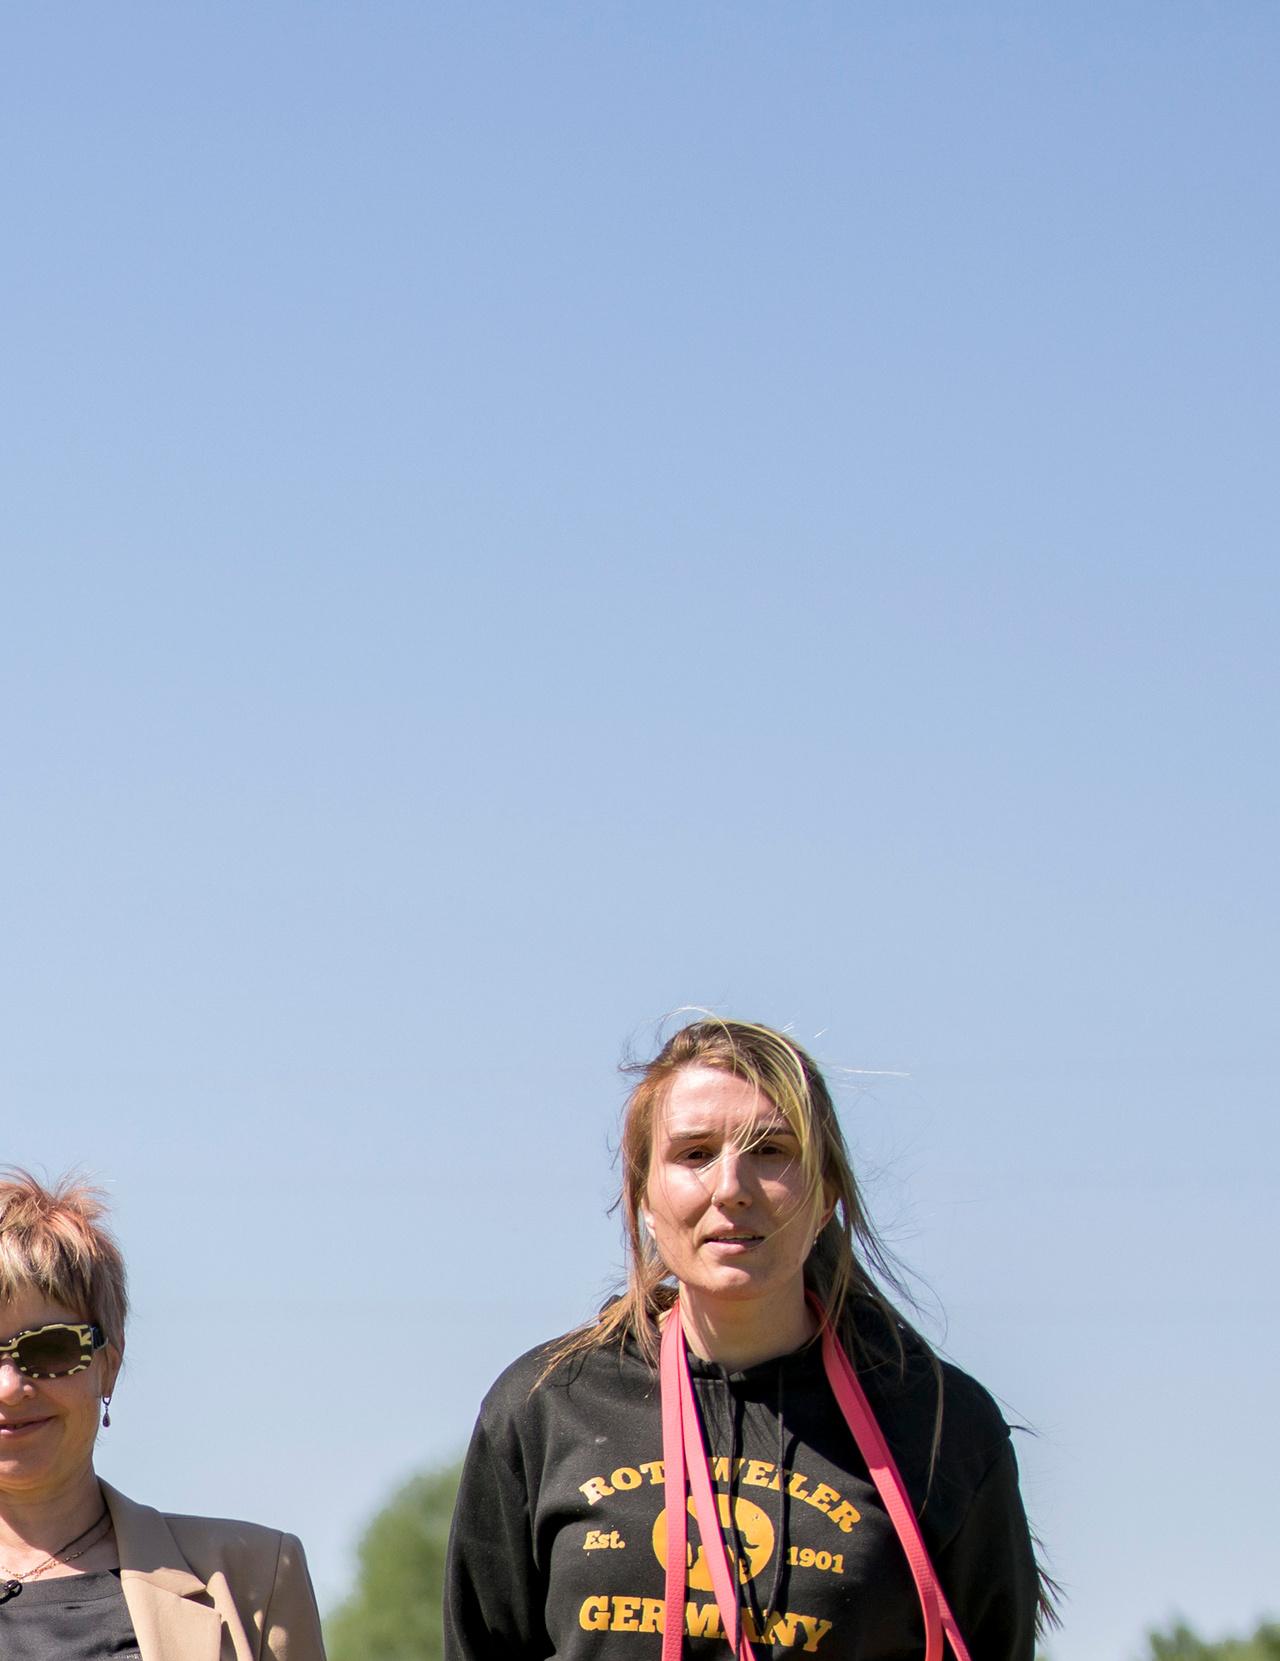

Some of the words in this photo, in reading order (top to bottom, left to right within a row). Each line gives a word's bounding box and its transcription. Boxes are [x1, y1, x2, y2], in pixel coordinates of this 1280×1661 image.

[579, 1456, 862, 1533] ROTWEILER
[583, 1530, 626, 1550] Est.
[787, 1546, 844, 1574] 1901
